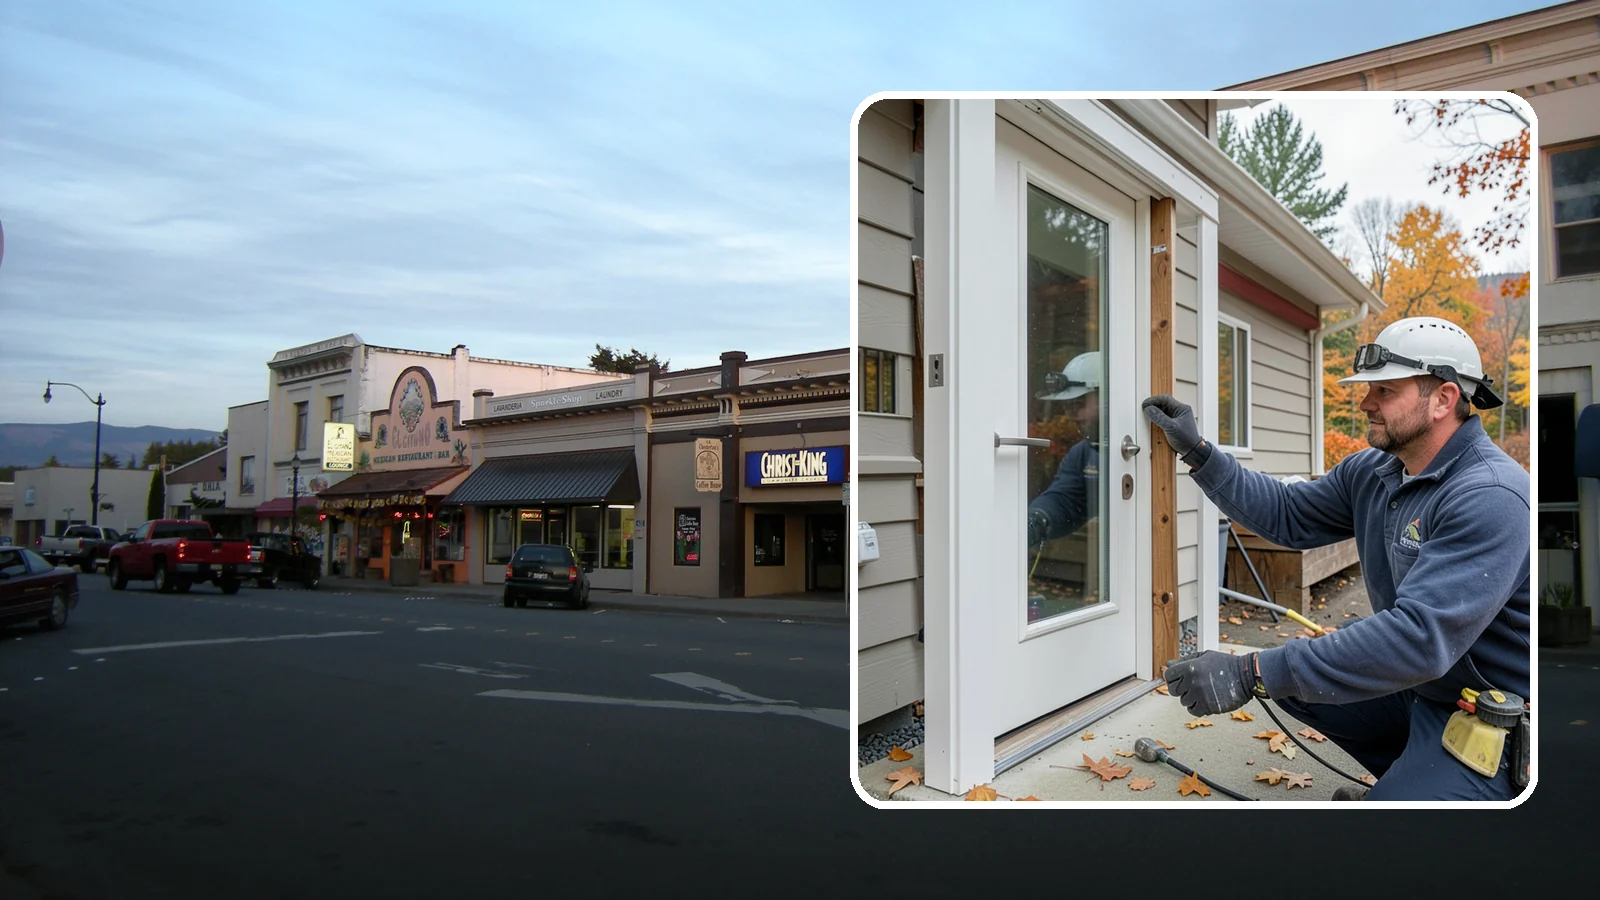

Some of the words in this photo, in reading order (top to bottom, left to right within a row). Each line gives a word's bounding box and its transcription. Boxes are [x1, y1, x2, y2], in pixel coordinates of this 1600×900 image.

[493, 402, 522, 412] LAVANDERIA
[530, 397, 561, 409] Sparkle
[562, 393, 582, 406] Shop
[595, 389, 623, 400] LAUNDRY
[397, 451, 433, 462] RESTAURANT
[438, 450, 450, 459] BAR
[761, 452, 797, 478] CHRIST
[799, 450, 828, 477] KING
